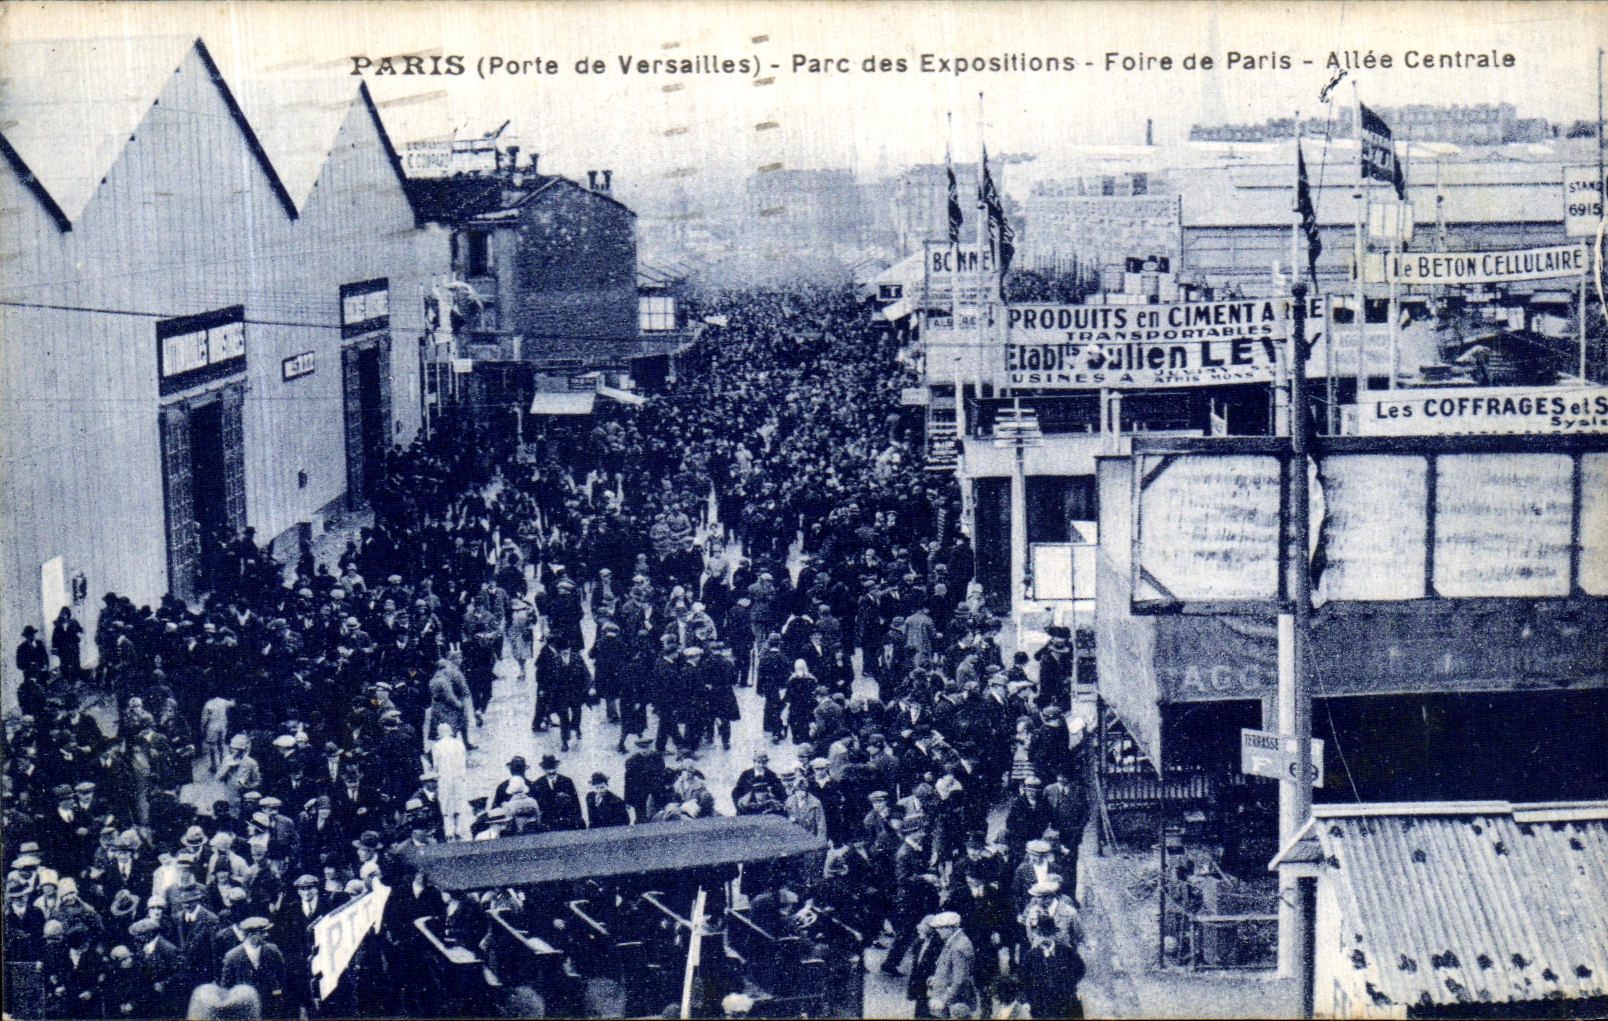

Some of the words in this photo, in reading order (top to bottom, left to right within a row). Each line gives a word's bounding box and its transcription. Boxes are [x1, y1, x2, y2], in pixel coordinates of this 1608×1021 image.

[1568, 203, 1602, 217] 6915
[1418, 255, 1477, 278] BETON
[1482, 249, 1583, 277] CELLULAIRE
[1008, 308, 1128, 330] PRODUITS
[1136, 310, 1160, 328] en
[1168, 302, 1256, 328] CIMENT
[1066, 324, 1273, 341] TRANSPORTABLES
[1012, 373, 1106, 384] USINES
[1376, 401, 1414, 419] Les
[1423, 396, 1566, 418] COFFRAGES
[1570, 398, 1591, 415] et
[1244, 733, 1280, 752] TERRASSE
